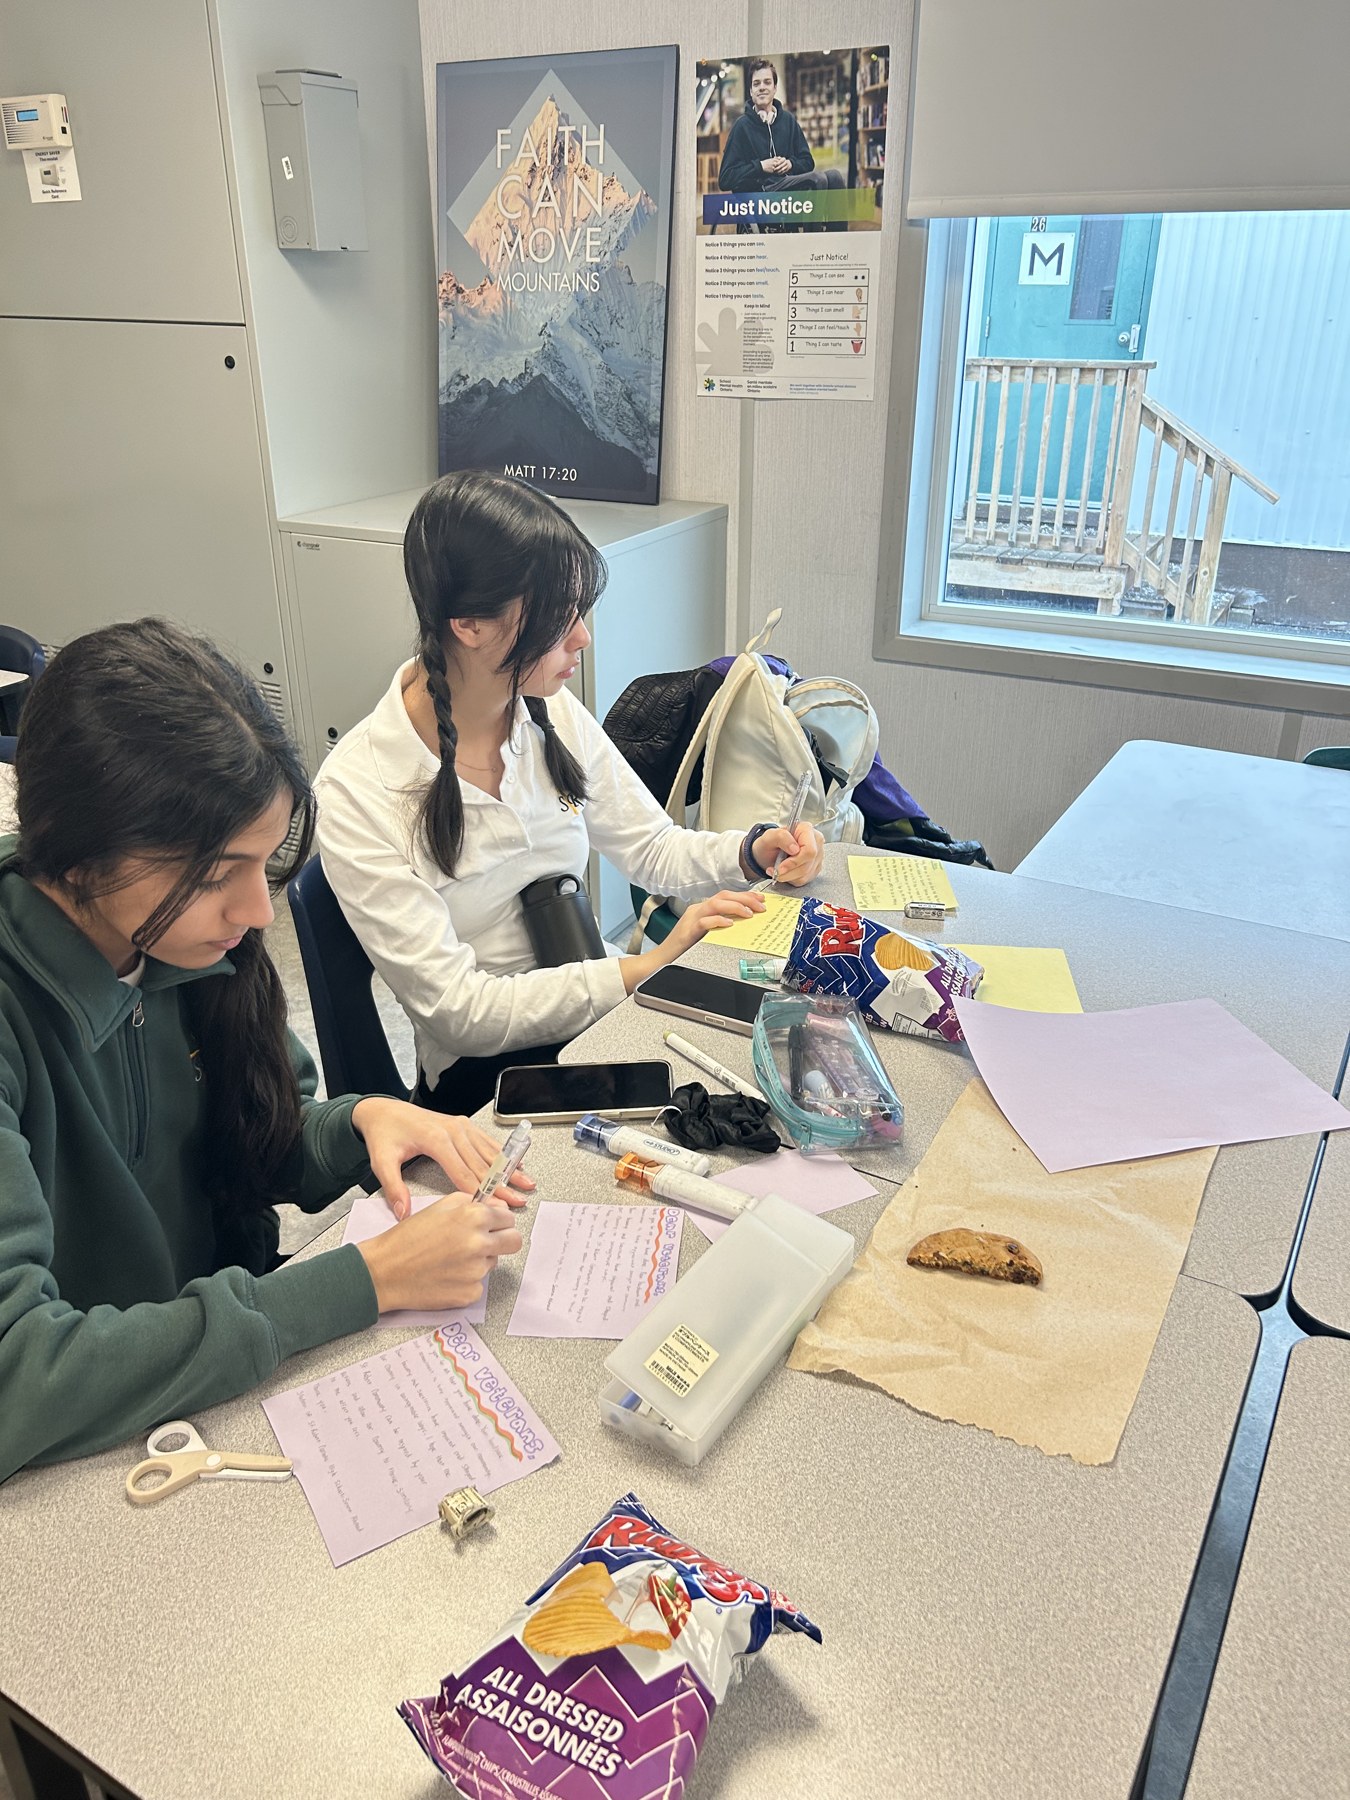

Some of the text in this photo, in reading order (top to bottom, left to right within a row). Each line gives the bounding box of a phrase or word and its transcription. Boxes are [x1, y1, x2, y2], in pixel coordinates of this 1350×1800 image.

[496, 124, 604, 168] FAITH
[496, 172, 602, 219] CAN
[720, 196, 814, 216] Just Notice
[1032, 217, 1046, 232] 26
[496, 228, 602, 262] MOVE
[1028, 243, 1065, 276] M
[496, 272, 600, 293] MOUNTAINS
[791, 273, 798, 284] 5
[791, 290, 798, 301] 4
[790, 307, 797, 319] 3
[790, 324, 796, 335] 2
[790, 341, 794, 352] 1
[504, 464, 578, 482] MATT 17:20
[940, 972, 951, 990] ALL
[442, 1322, 480, 1361] Dear
[482, 1666, 624, 1743] ALL DRESSED
[454, 1683, 622, 1777] ASSAISONNÉES
[480, 1758, 541, 1798] CHIPS/CROUSTILLES
